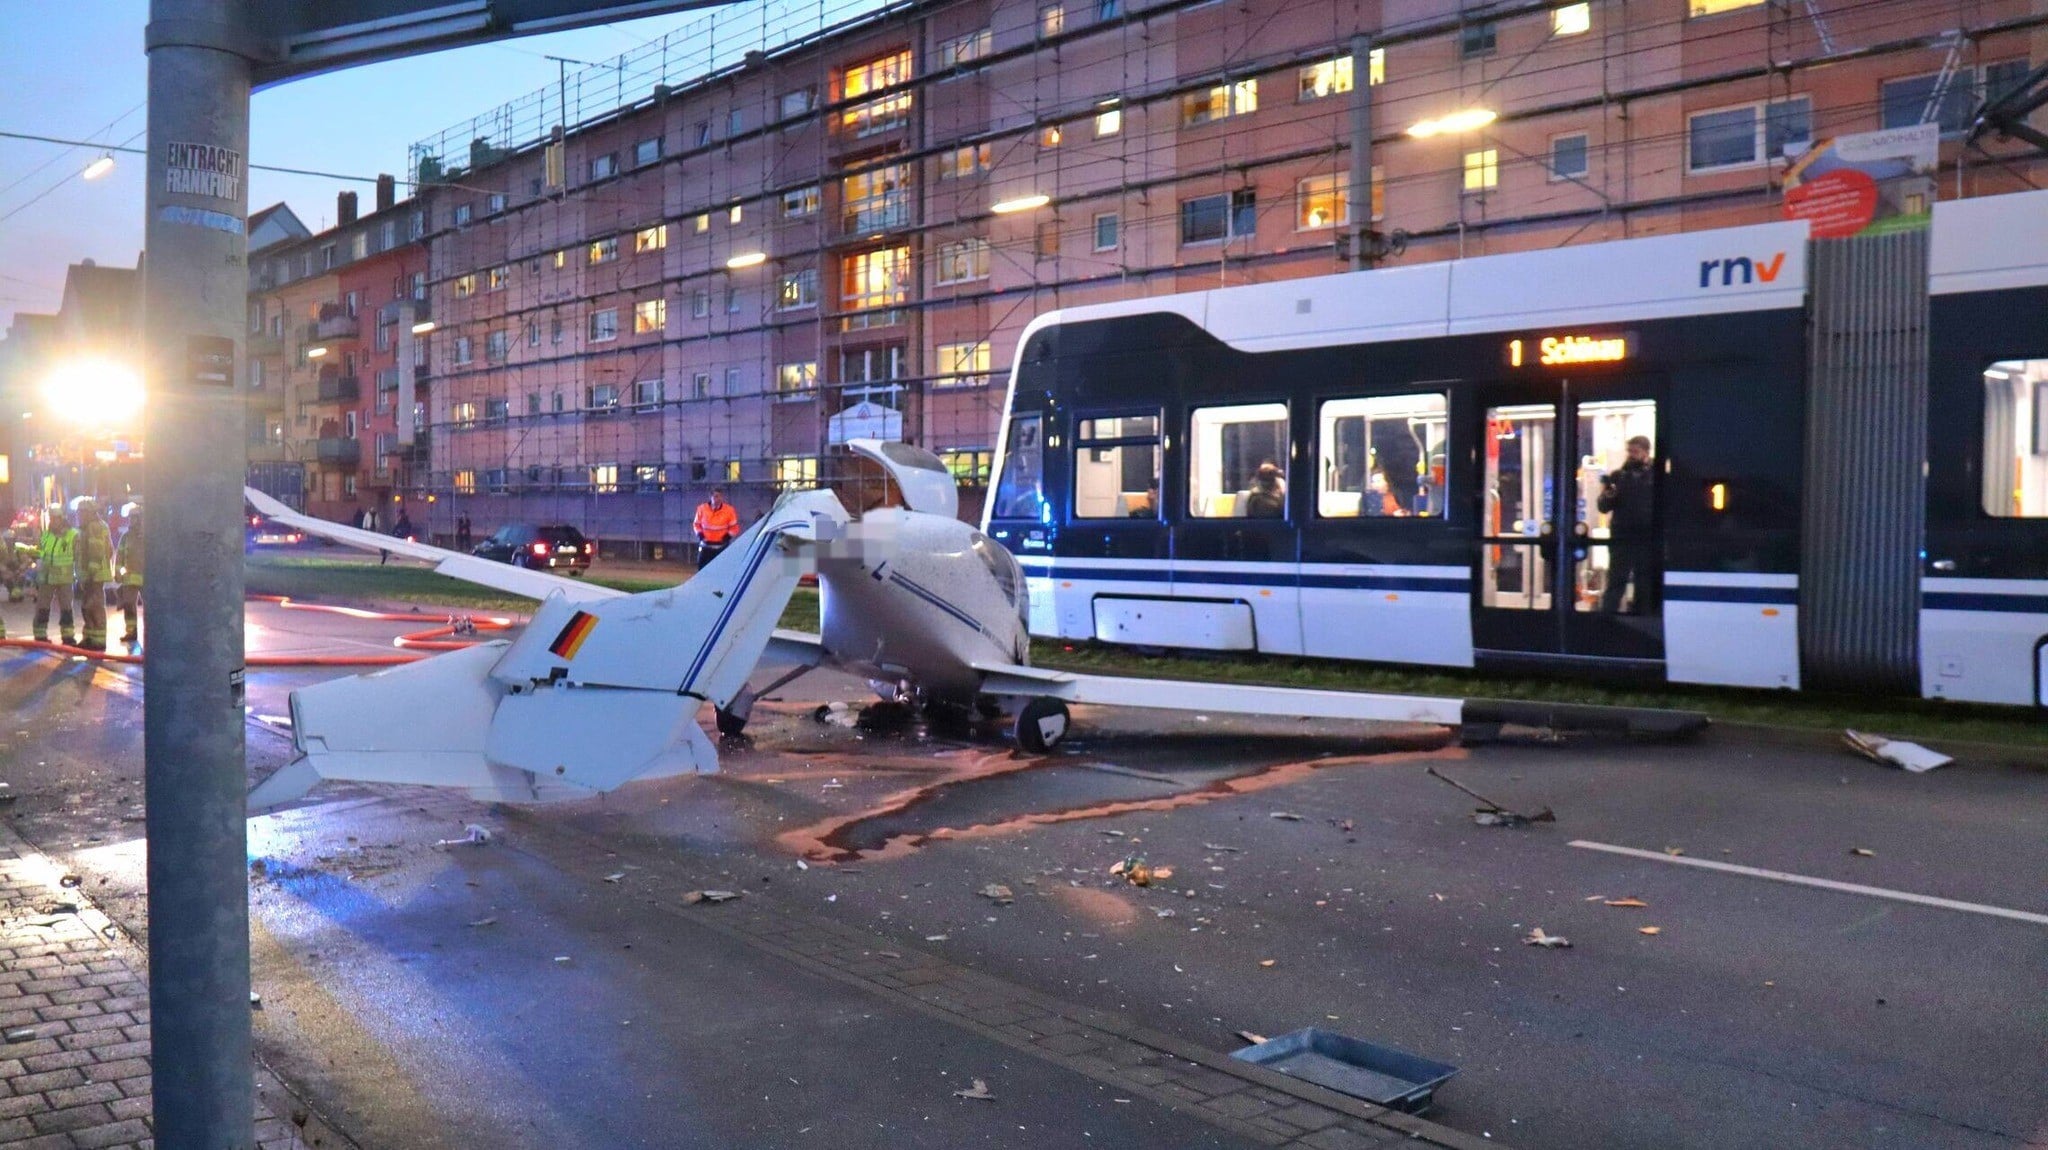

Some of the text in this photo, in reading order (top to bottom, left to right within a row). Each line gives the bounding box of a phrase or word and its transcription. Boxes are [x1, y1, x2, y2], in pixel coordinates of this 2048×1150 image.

[167, 142, 240, 177] EINTRACHT
[166, 167, 239, 201] FRANKFURT
[1699, 251, 1785, 287] rnv
[1509, 340, 1522, 367] 1
[1711, 484, 1724, 510] 1
